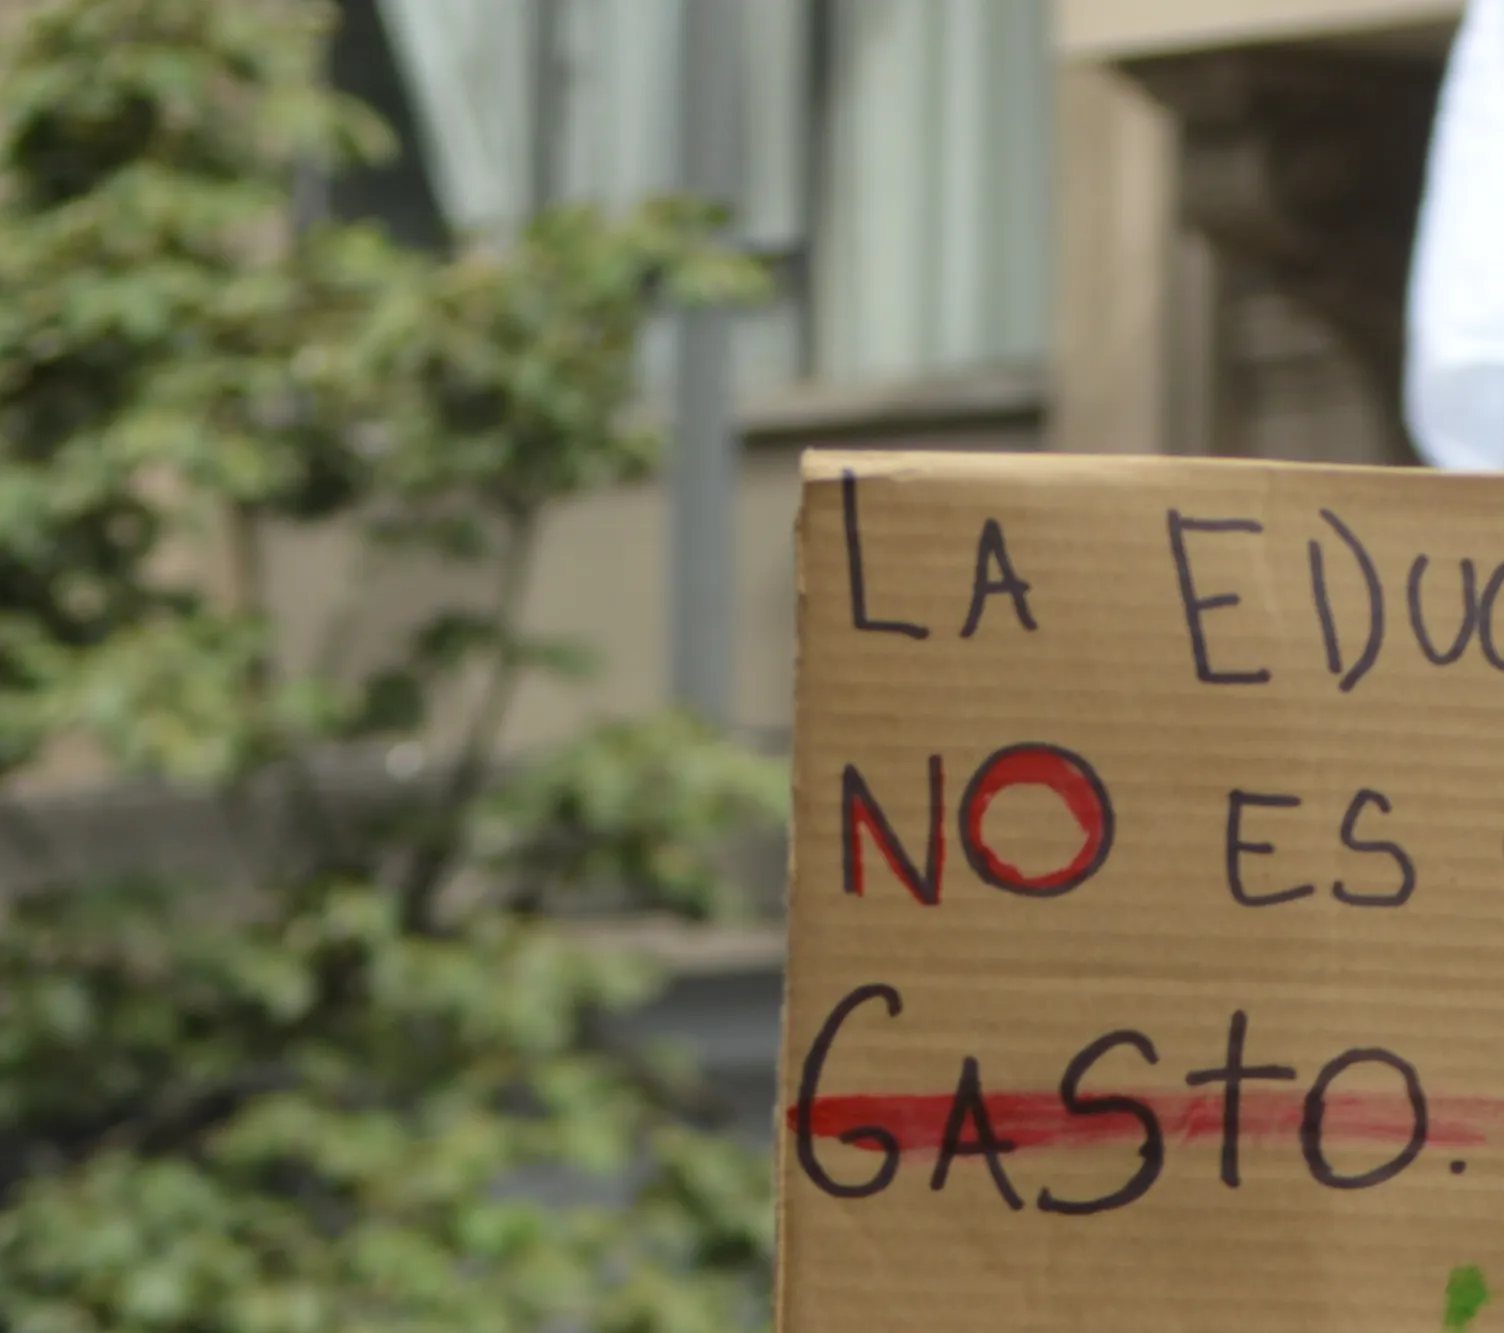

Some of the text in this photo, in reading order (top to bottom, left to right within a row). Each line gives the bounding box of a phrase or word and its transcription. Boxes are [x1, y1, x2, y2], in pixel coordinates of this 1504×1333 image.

[842, 469, 1038, 638] LA
[841, 742, 1116, 905] NO
[1224, 788, 1418, 907] ES
